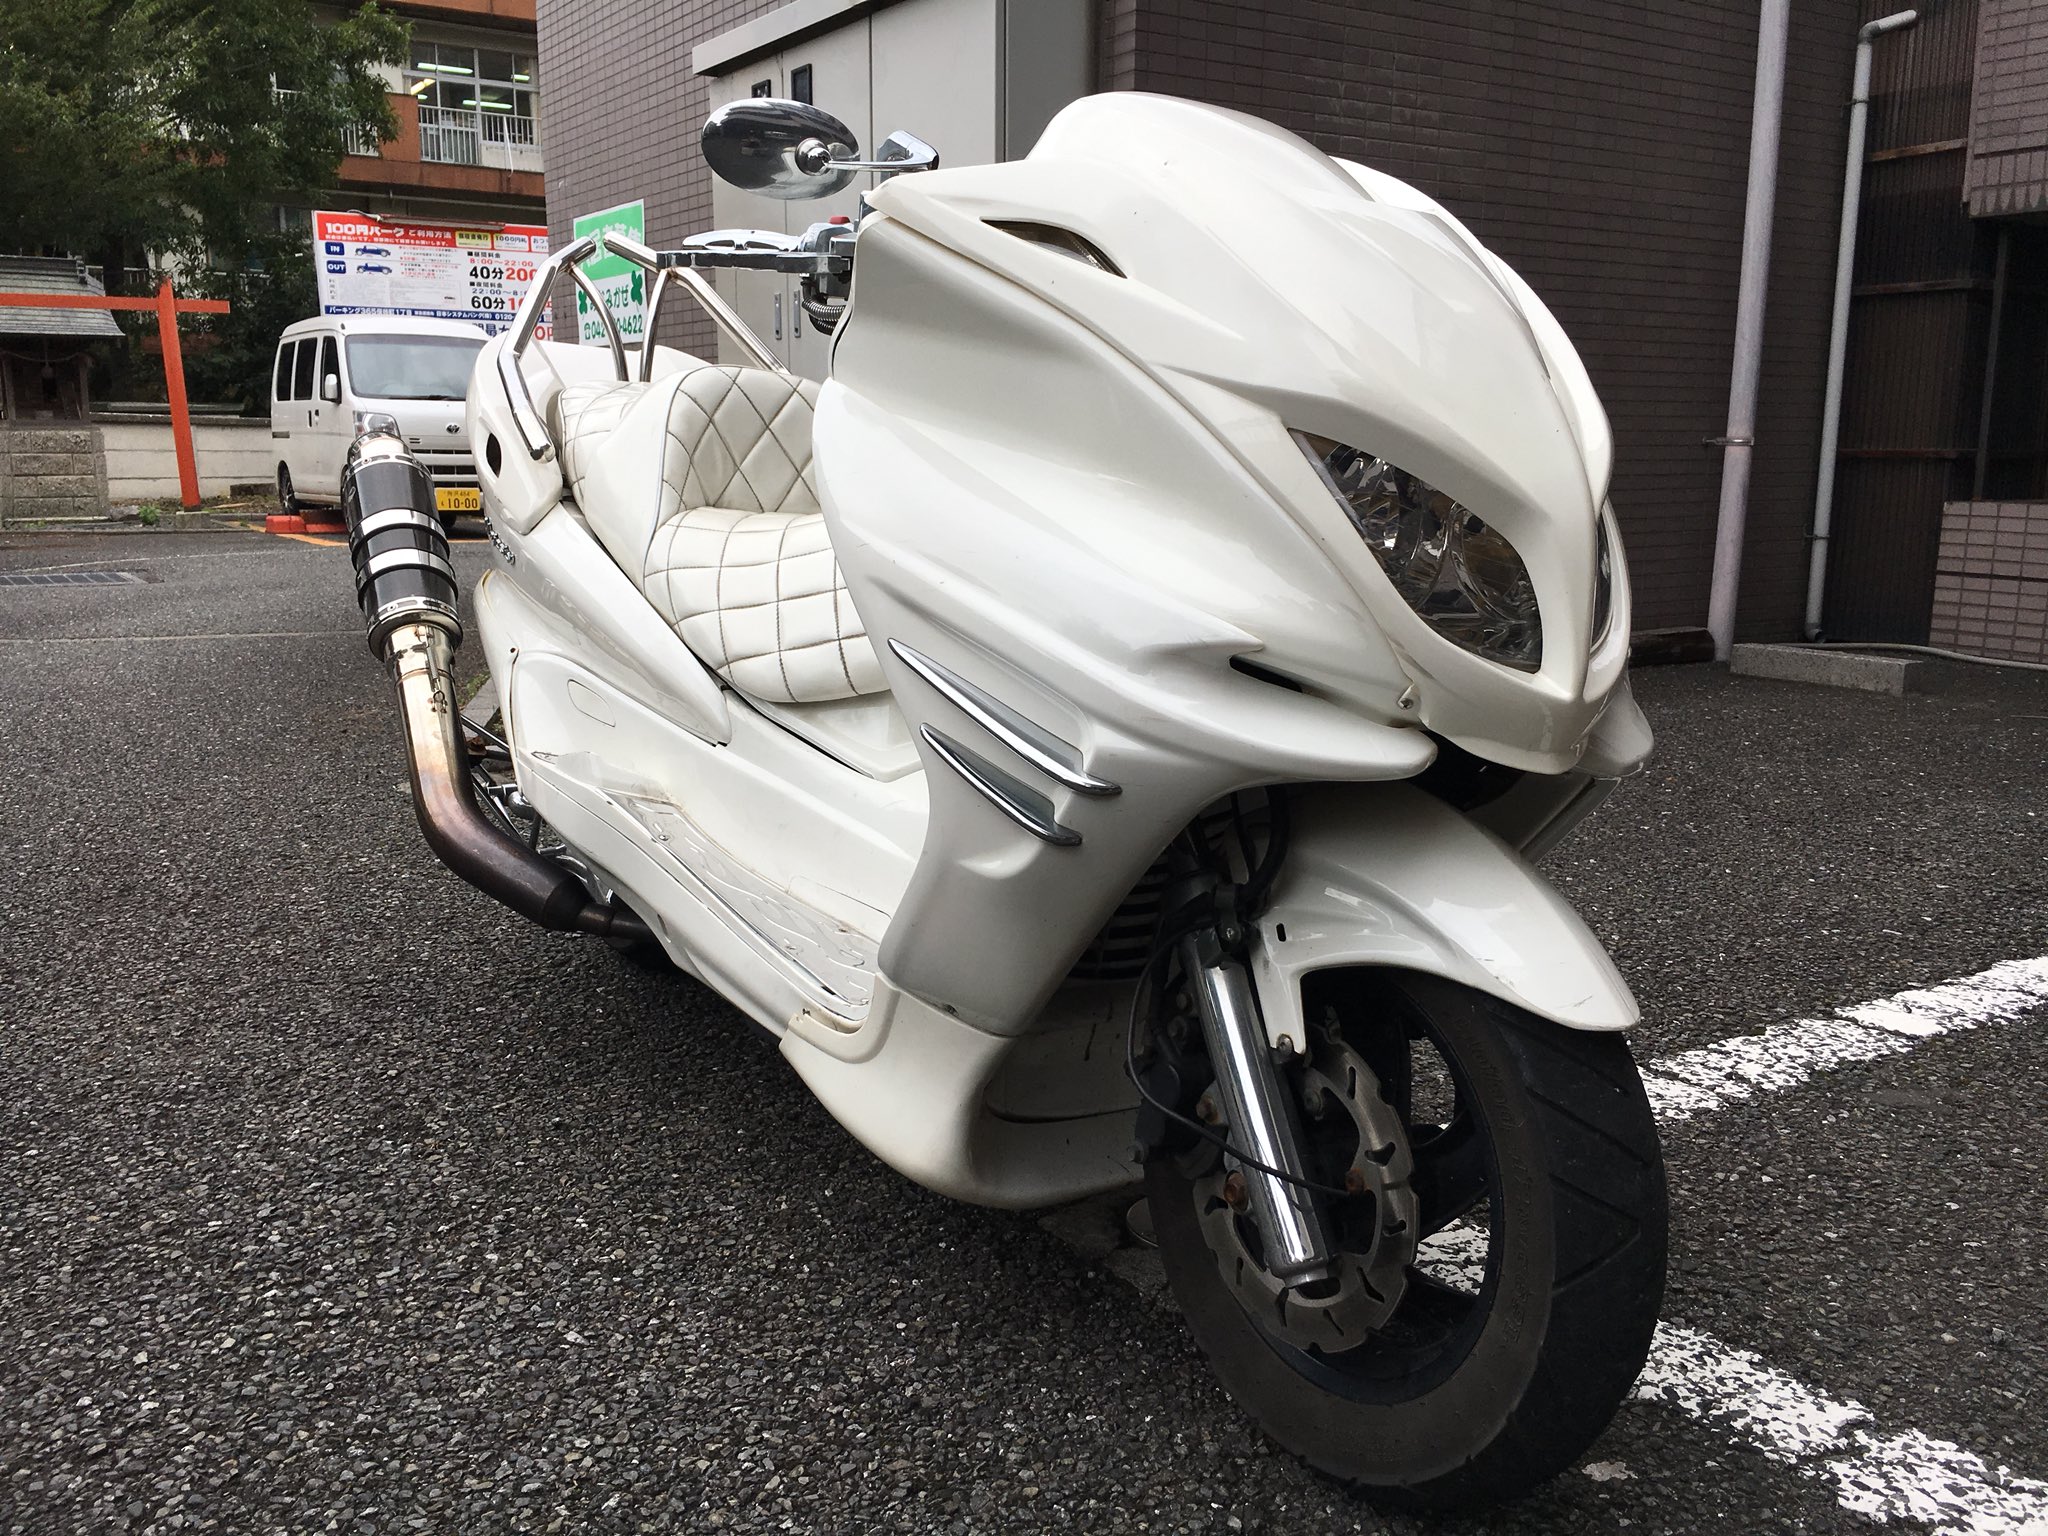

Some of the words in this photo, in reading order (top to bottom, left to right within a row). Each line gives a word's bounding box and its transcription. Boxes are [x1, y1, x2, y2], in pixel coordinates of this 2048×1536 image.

[325, 222, 405, 238] 100円パーク
[409, 229, 452, 239] ご利用方法
[327, 263, 345, 271] OUT
[448, 498, 478, 509] 10-00
